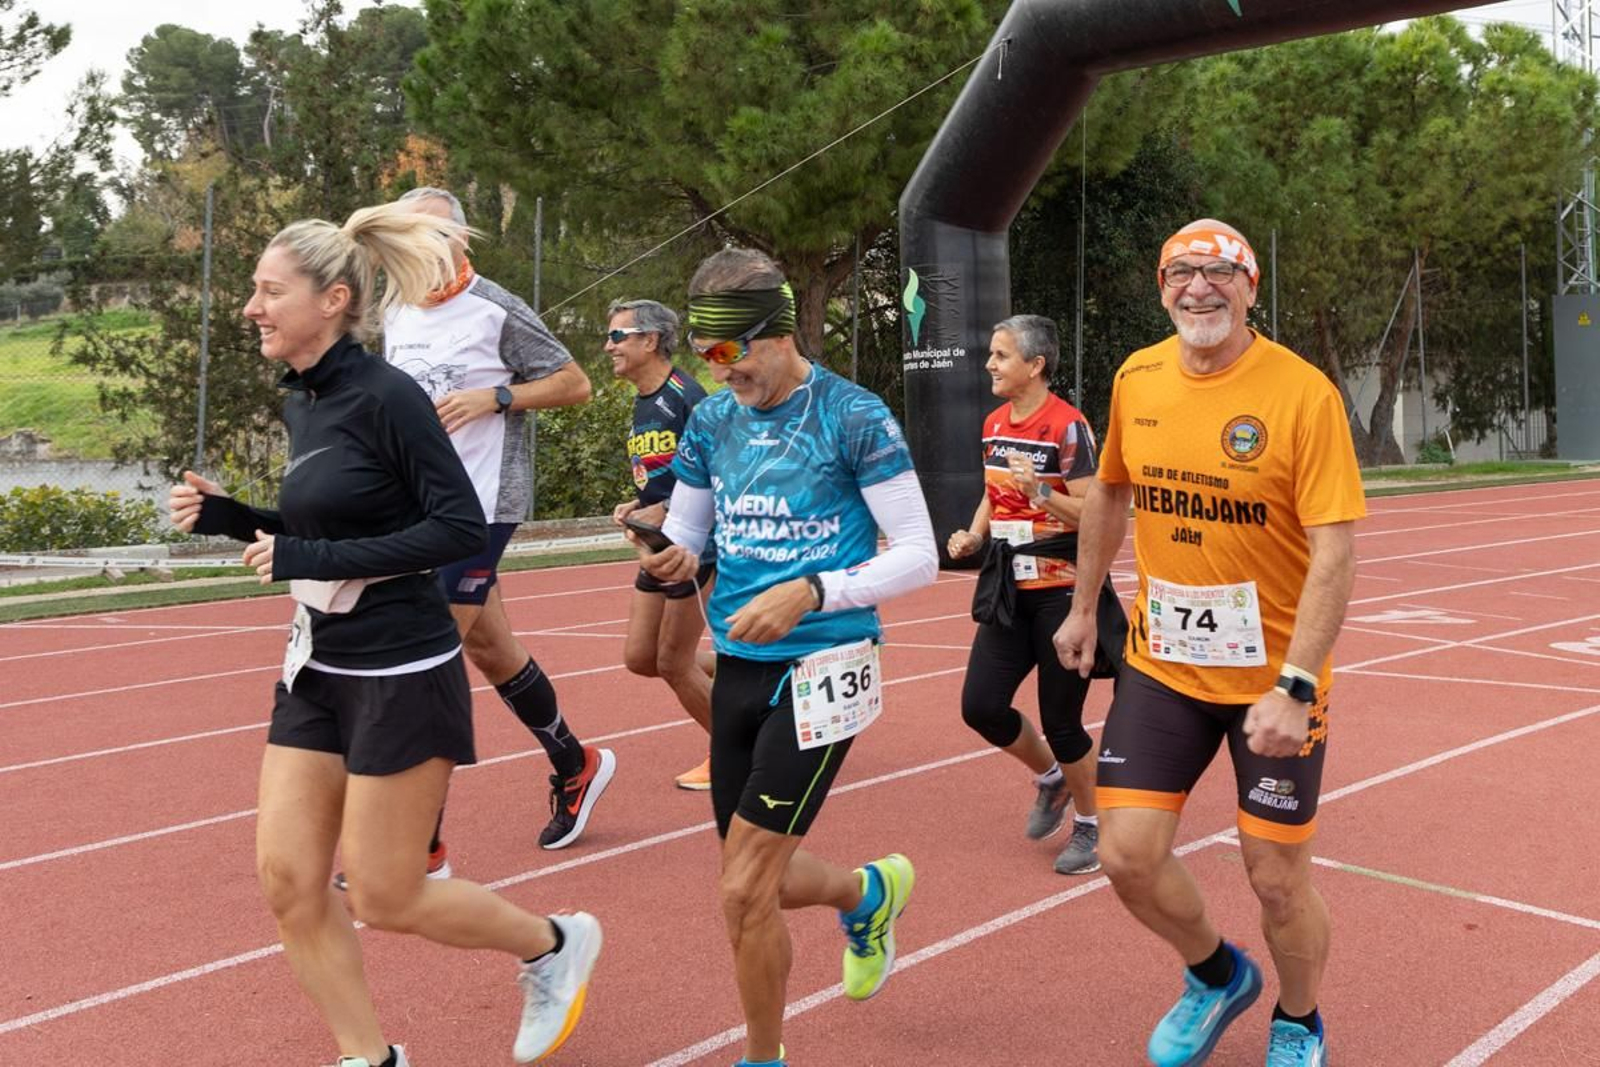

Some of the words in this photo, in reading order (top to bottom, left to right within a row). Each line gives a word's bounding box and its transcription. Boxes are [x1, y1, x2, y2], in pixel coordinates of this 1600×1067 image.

[912, 347, 951, 360] Municipal
[952, 347, 966, 357] de
[919, 359, 930, 369] de
[931, 358, 954, 369] Jaén
[1142, 465, 1164, 479] CLUB
[1166, 468, 1179, 481] DE
[1181, 470, 1229, 490] ATLETISMO
[724, 493, 793, 518] MEDIA
[1132, 482, 1268, 527] UIEBRAJANO
[727, 514, 840, 541] MARATÓN
[801, 542, 839, 561] 2024
[1173, 606, 1219, 633] 74
[817, 664, 871, 703] 136
